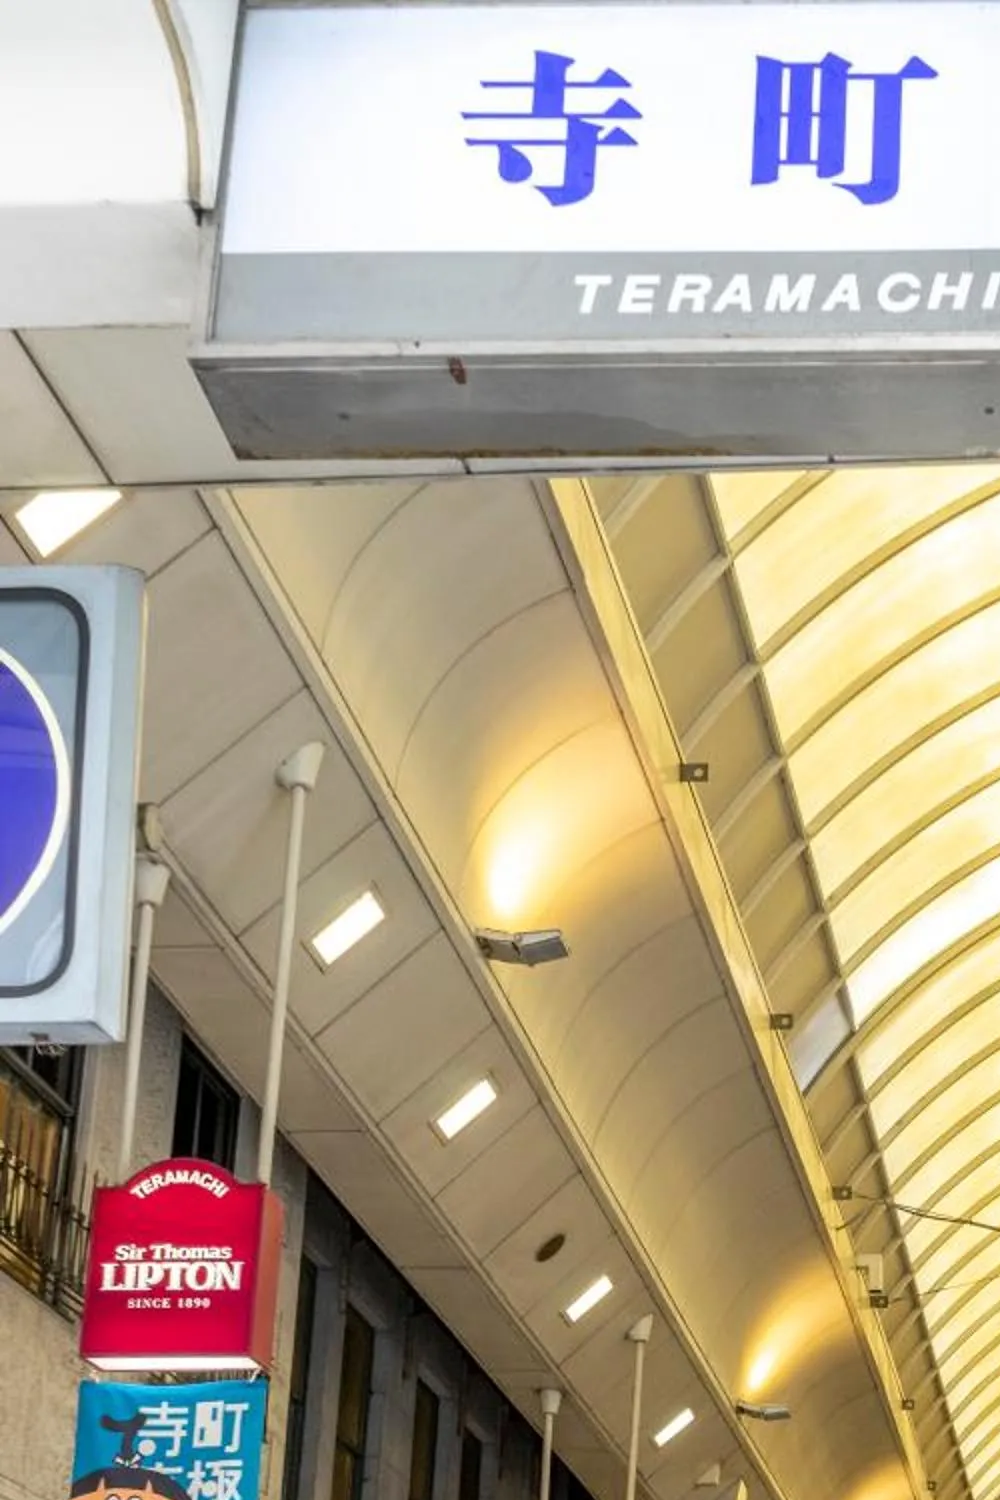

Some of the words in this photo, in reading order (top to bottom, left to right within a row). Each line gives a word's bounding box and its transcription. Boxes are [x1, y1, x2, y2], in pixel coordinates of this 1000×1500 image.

[129, 1169, 231, 1199] TERAMACHI
[115, 1243, 146, 1261] Sir
[149, 1242, 233, 1261] Thomas
[99, 1260, 246, 1292] LIPTON
[127, 1297, 171, 1309] SINCE
[178, 1297, 211, 1309] 1890
[137, 1400, 250, 1458] 寺町
